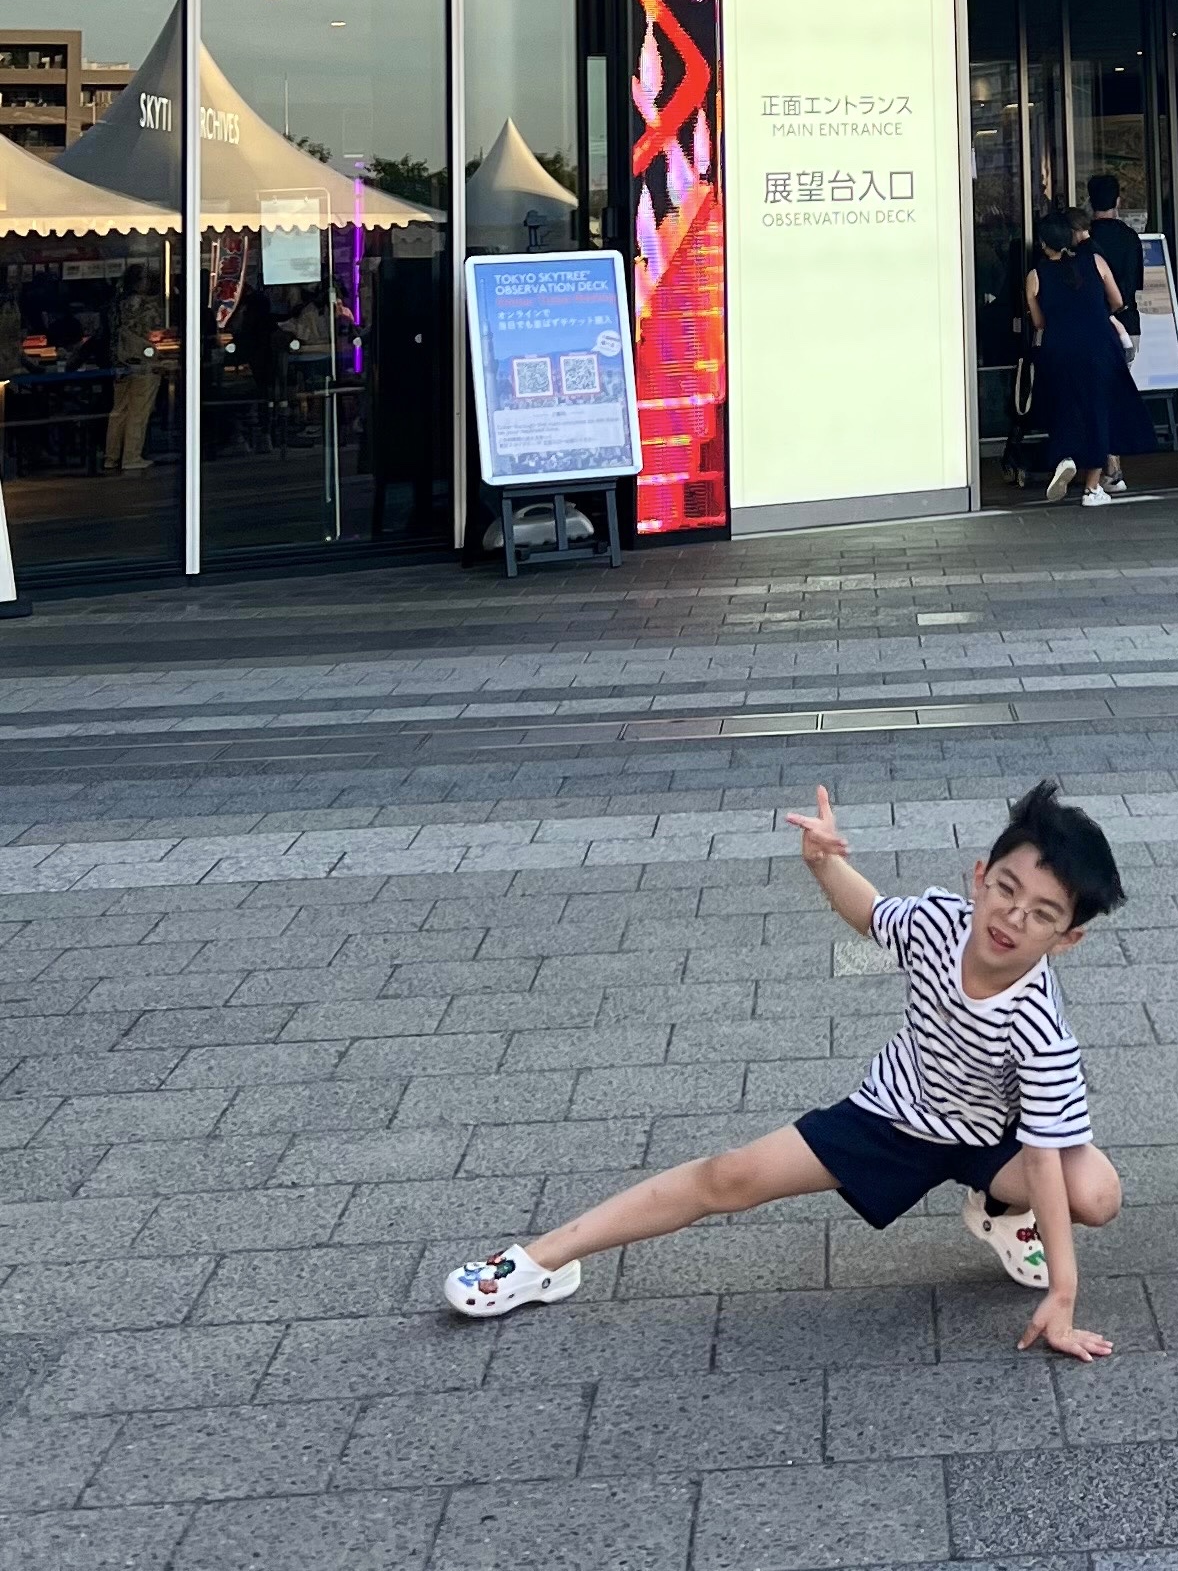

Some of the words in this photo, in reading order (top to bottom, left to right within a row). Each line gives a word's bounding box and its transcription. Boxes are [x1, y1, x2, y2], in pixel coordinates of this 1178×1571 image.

[761, 95, 913, 116] 正面エントランス
[139, 92, 172, 132] SKYT
[200, 107, 240, 145] RCHIVES
[772, 123, 814, 137] MAIN
[819, 122, 903, 137] ENTRANCE
[763, 170, 915, 204] 展望台入口
[762, 210, 871, 227] OBSERVATION
[875, 208, 917, 224] DECK
[494, 272, 537, 285] TOKYO
[495, 283, 576, 296] OBSERVATION
[577, 280, 609, 292] DECK
